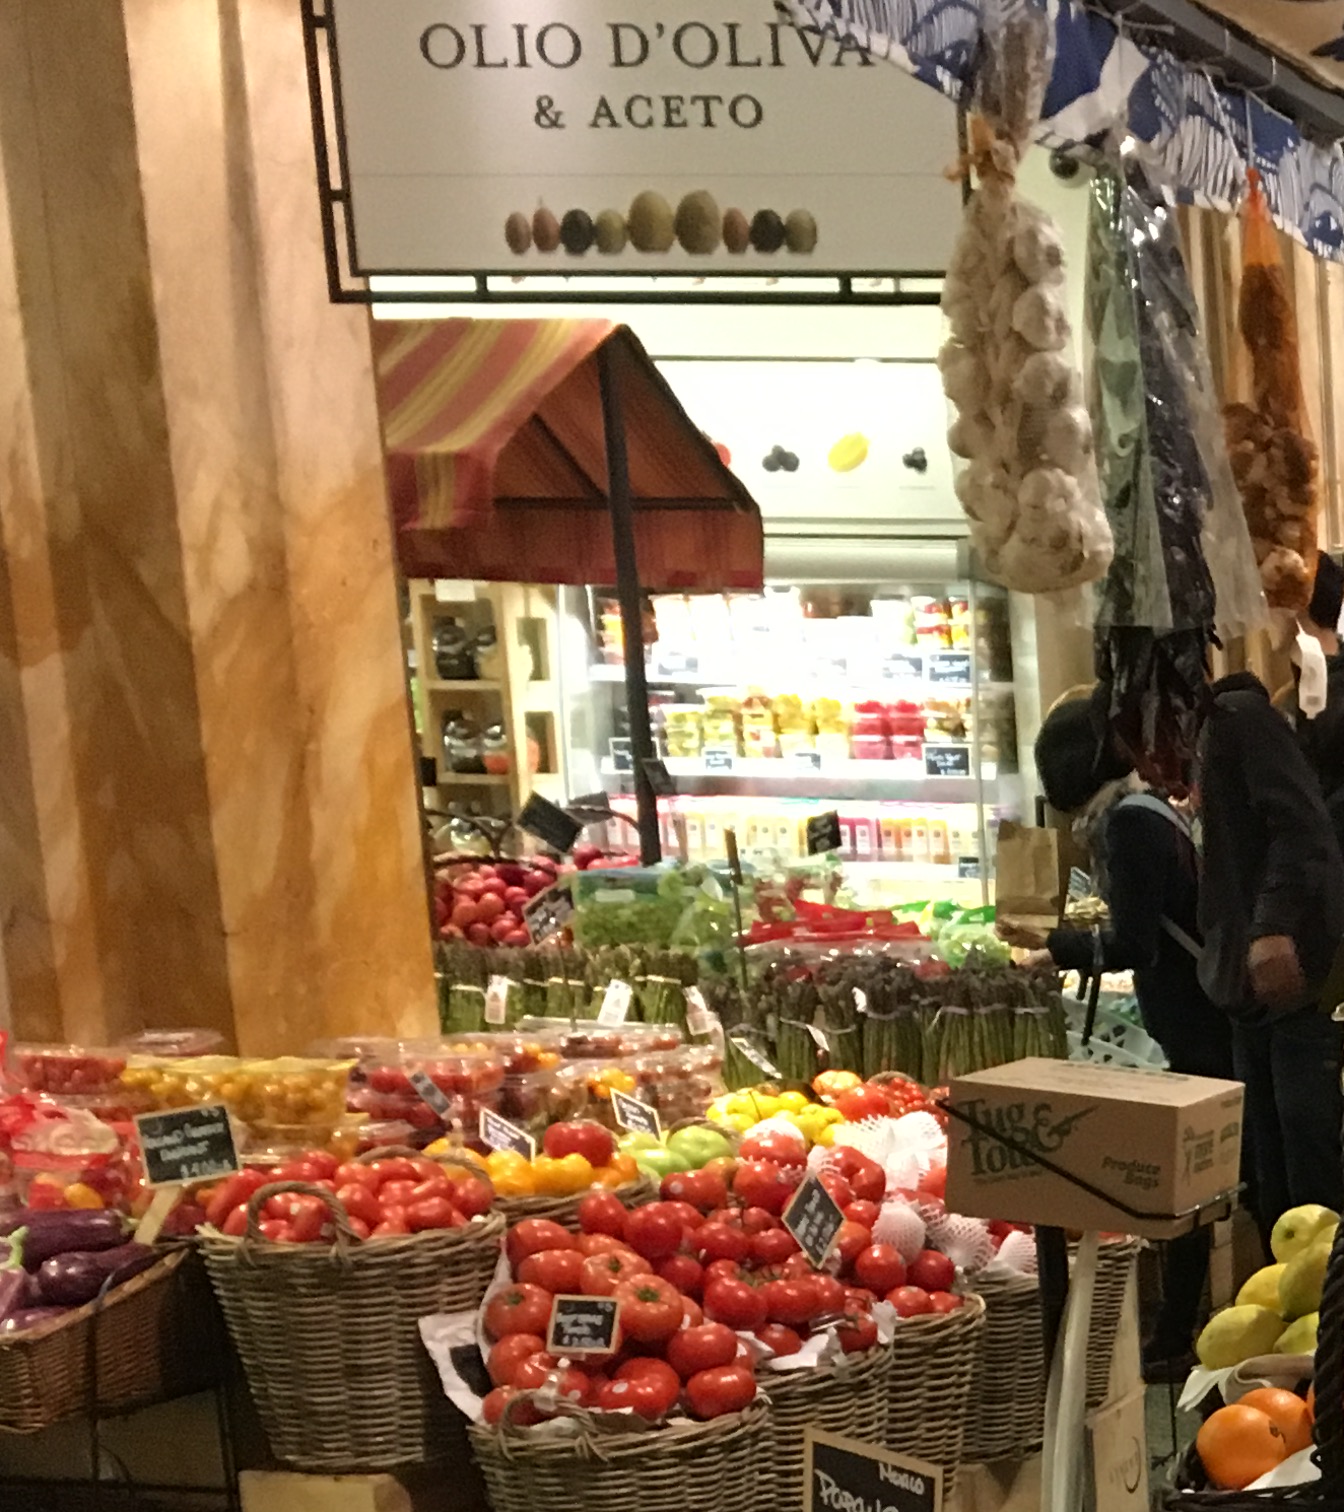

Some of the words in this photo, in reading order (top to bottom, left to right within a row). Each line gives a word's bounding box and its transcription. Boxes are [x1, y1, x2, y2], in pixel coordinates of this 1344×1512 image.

[419, 22, 583, 69] OLIO
[608, 22, 876, 69] D'OLIVA
[534, 95, 567, 130] &
[590, 94, 765, 129] ACETO
[1102, 1155, 1162, 1175] Produce
[1123, 1172, 1161, 1191] Bags
